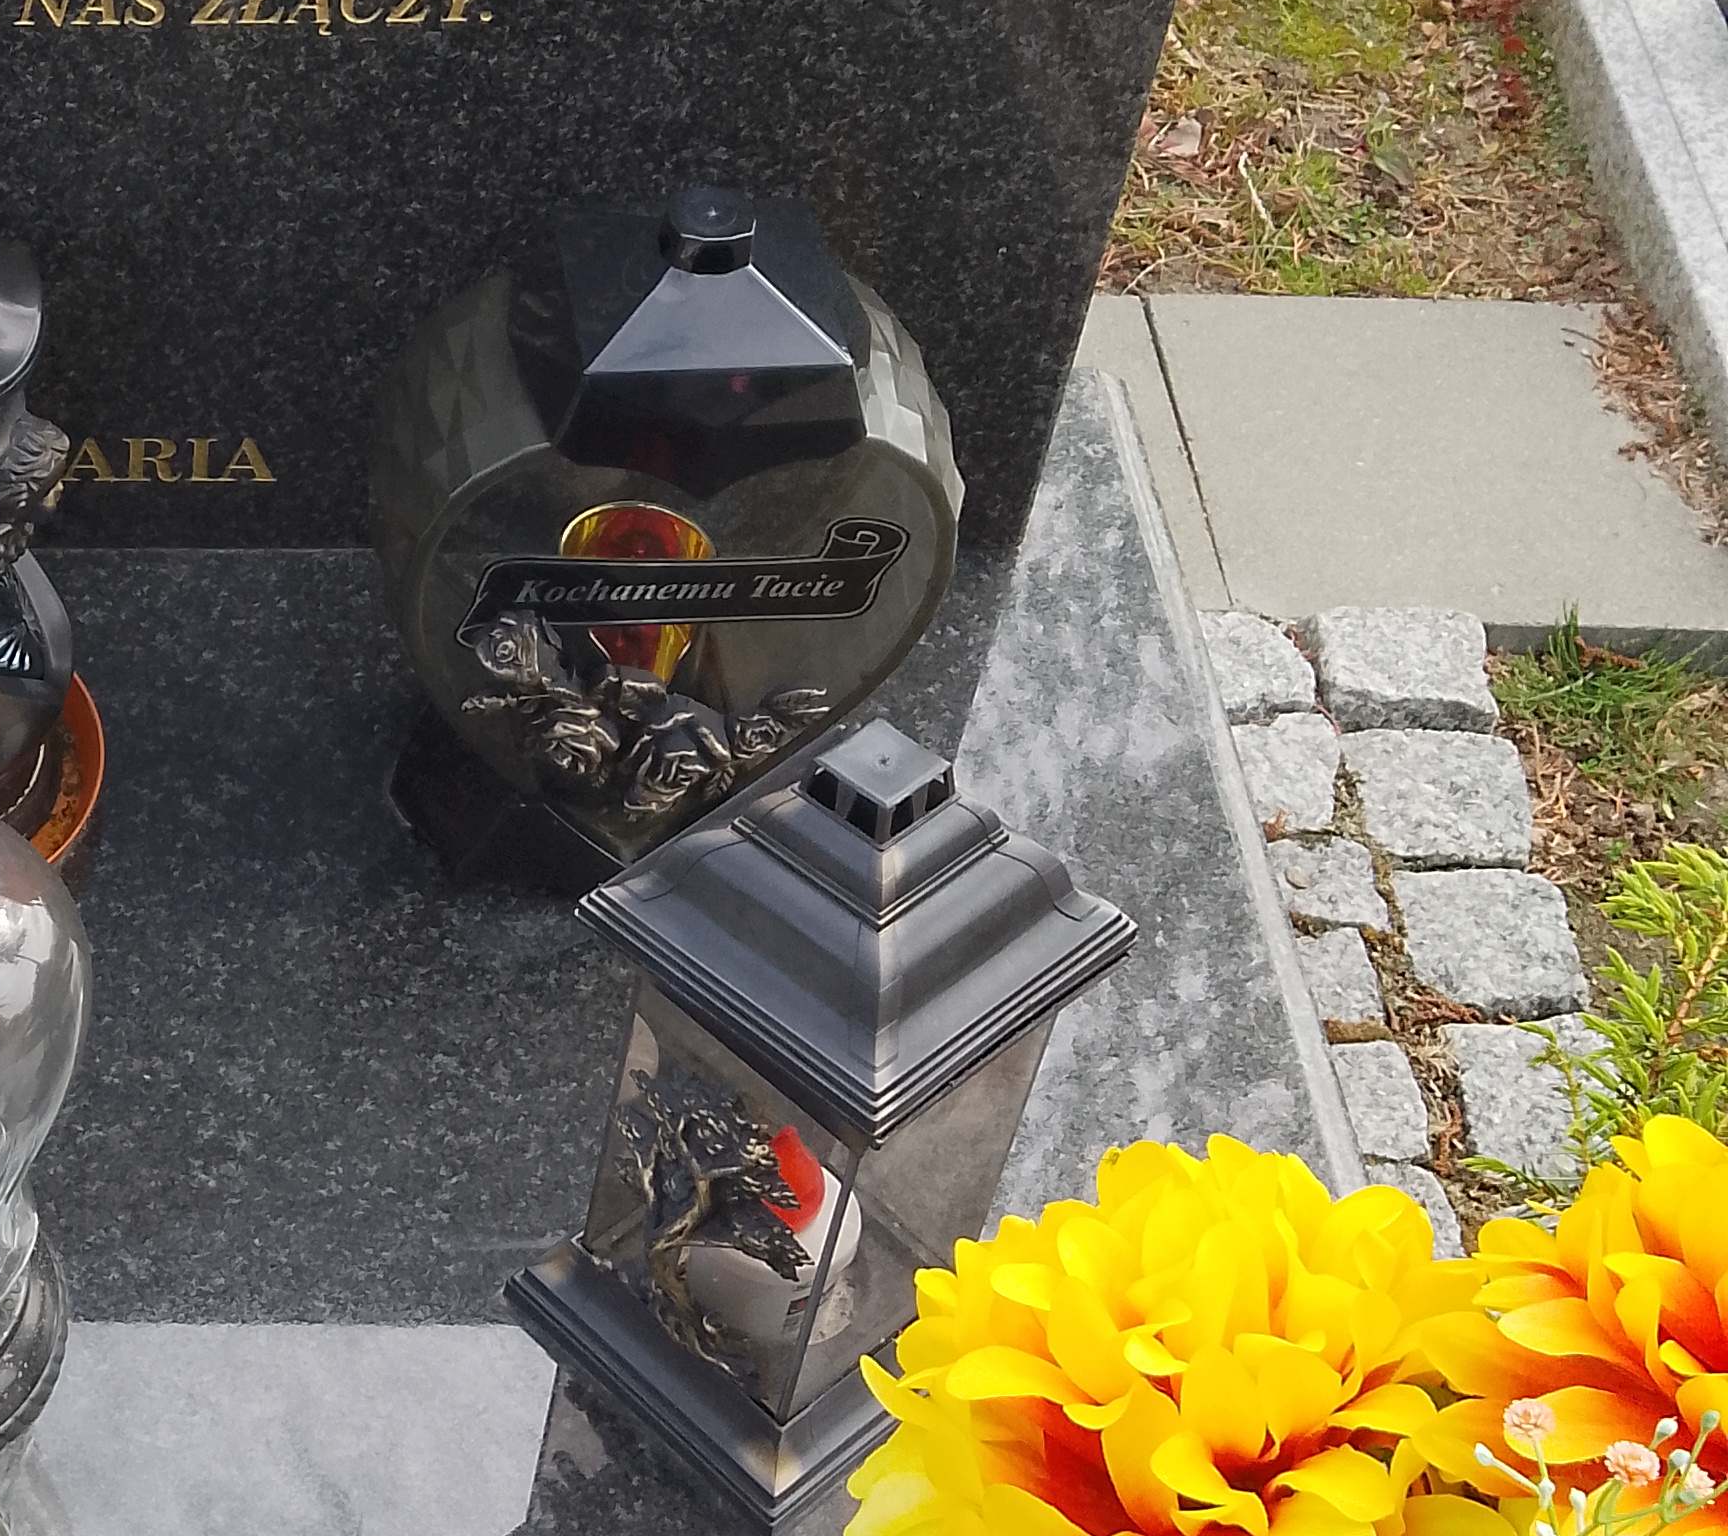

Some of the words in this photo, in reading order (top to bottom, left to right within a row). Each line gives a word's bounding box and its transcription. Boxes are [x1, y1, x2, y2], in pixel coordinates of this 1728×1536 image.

[60, 437, 278, 483] ARIA
[514, 578, 735, 606] Kochanemu
[749, 573, 846, 599] Tacie
